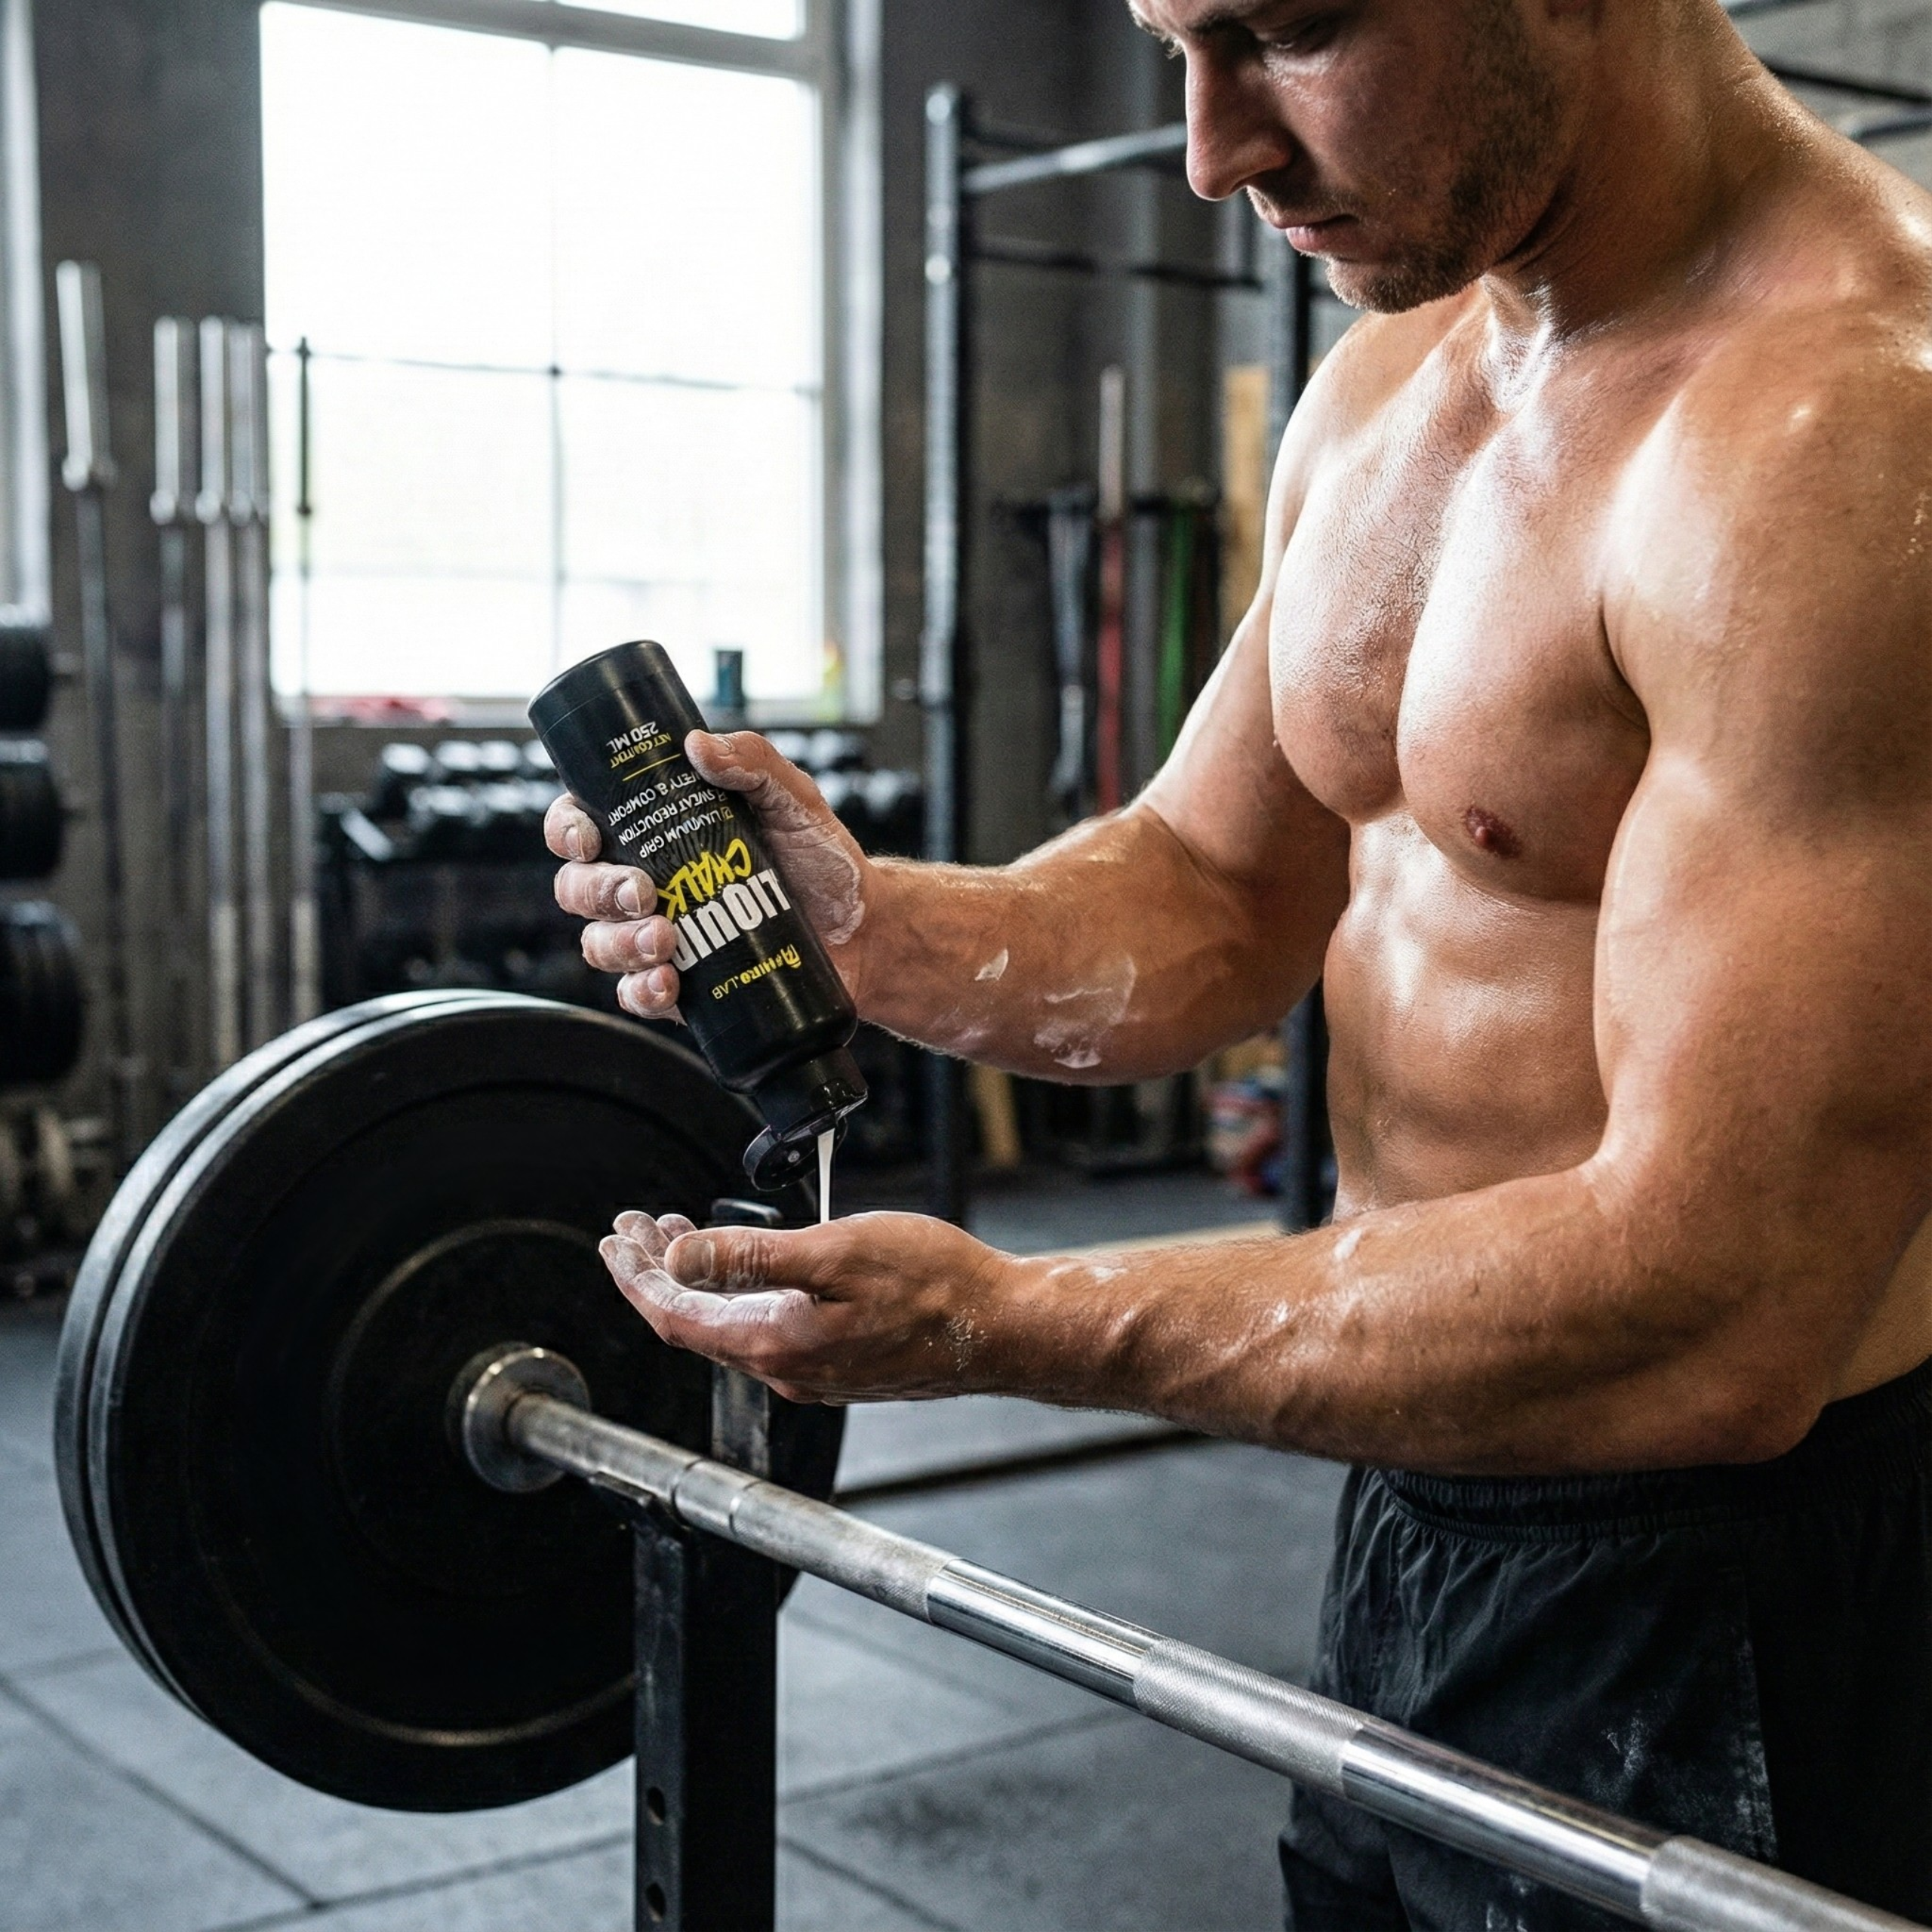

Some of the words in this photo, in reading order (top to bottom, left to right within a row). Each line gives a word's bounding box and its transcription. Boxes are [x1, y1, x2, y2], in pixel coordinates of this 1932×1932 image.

[606, 734, 631, 753] ML
[630, 721, 659, 743] 250
[608, 788, 656, 826] COMFORT
[618, 804, 678, 845] REDUCTION
[639, 835, 665, 858] GRIP
[657, 838, 751, 921] CHALK
